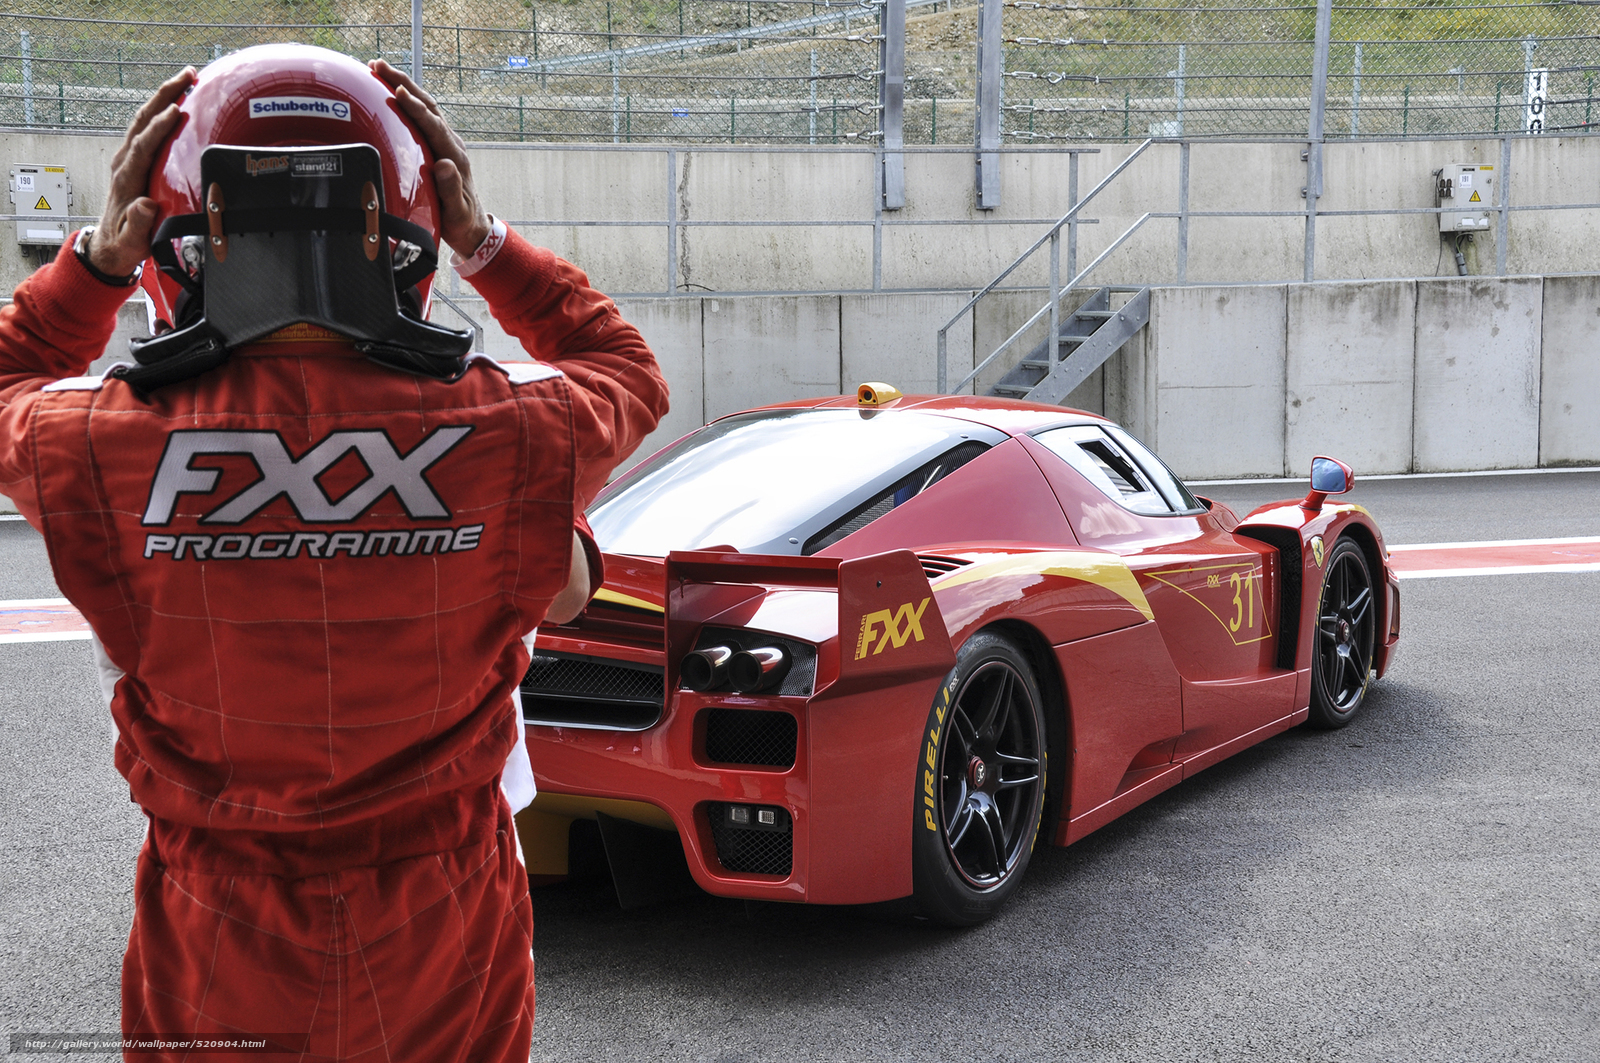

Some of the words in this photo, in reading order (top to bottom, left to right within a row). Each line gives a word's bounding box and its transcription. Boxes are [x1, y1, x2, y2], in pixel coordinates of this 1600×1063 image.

[253, 101, 329, 113] Schuberth
[20, 177, 31, 185] 190
[246, 154, 289, 176] hans
[295, 162, 337, 171] stand21
[476, 228, 499, 262] FXX
[141, 425, 477, 527] FXX
[143, 523, 485, 561] PROGRAMME
[1229, 571, 1254, 632] 31
[854, 614, 867, 661] FERRARI
[859, 596, 931, 659] FXX
[924, 686, 950, 832] PIRELLI
